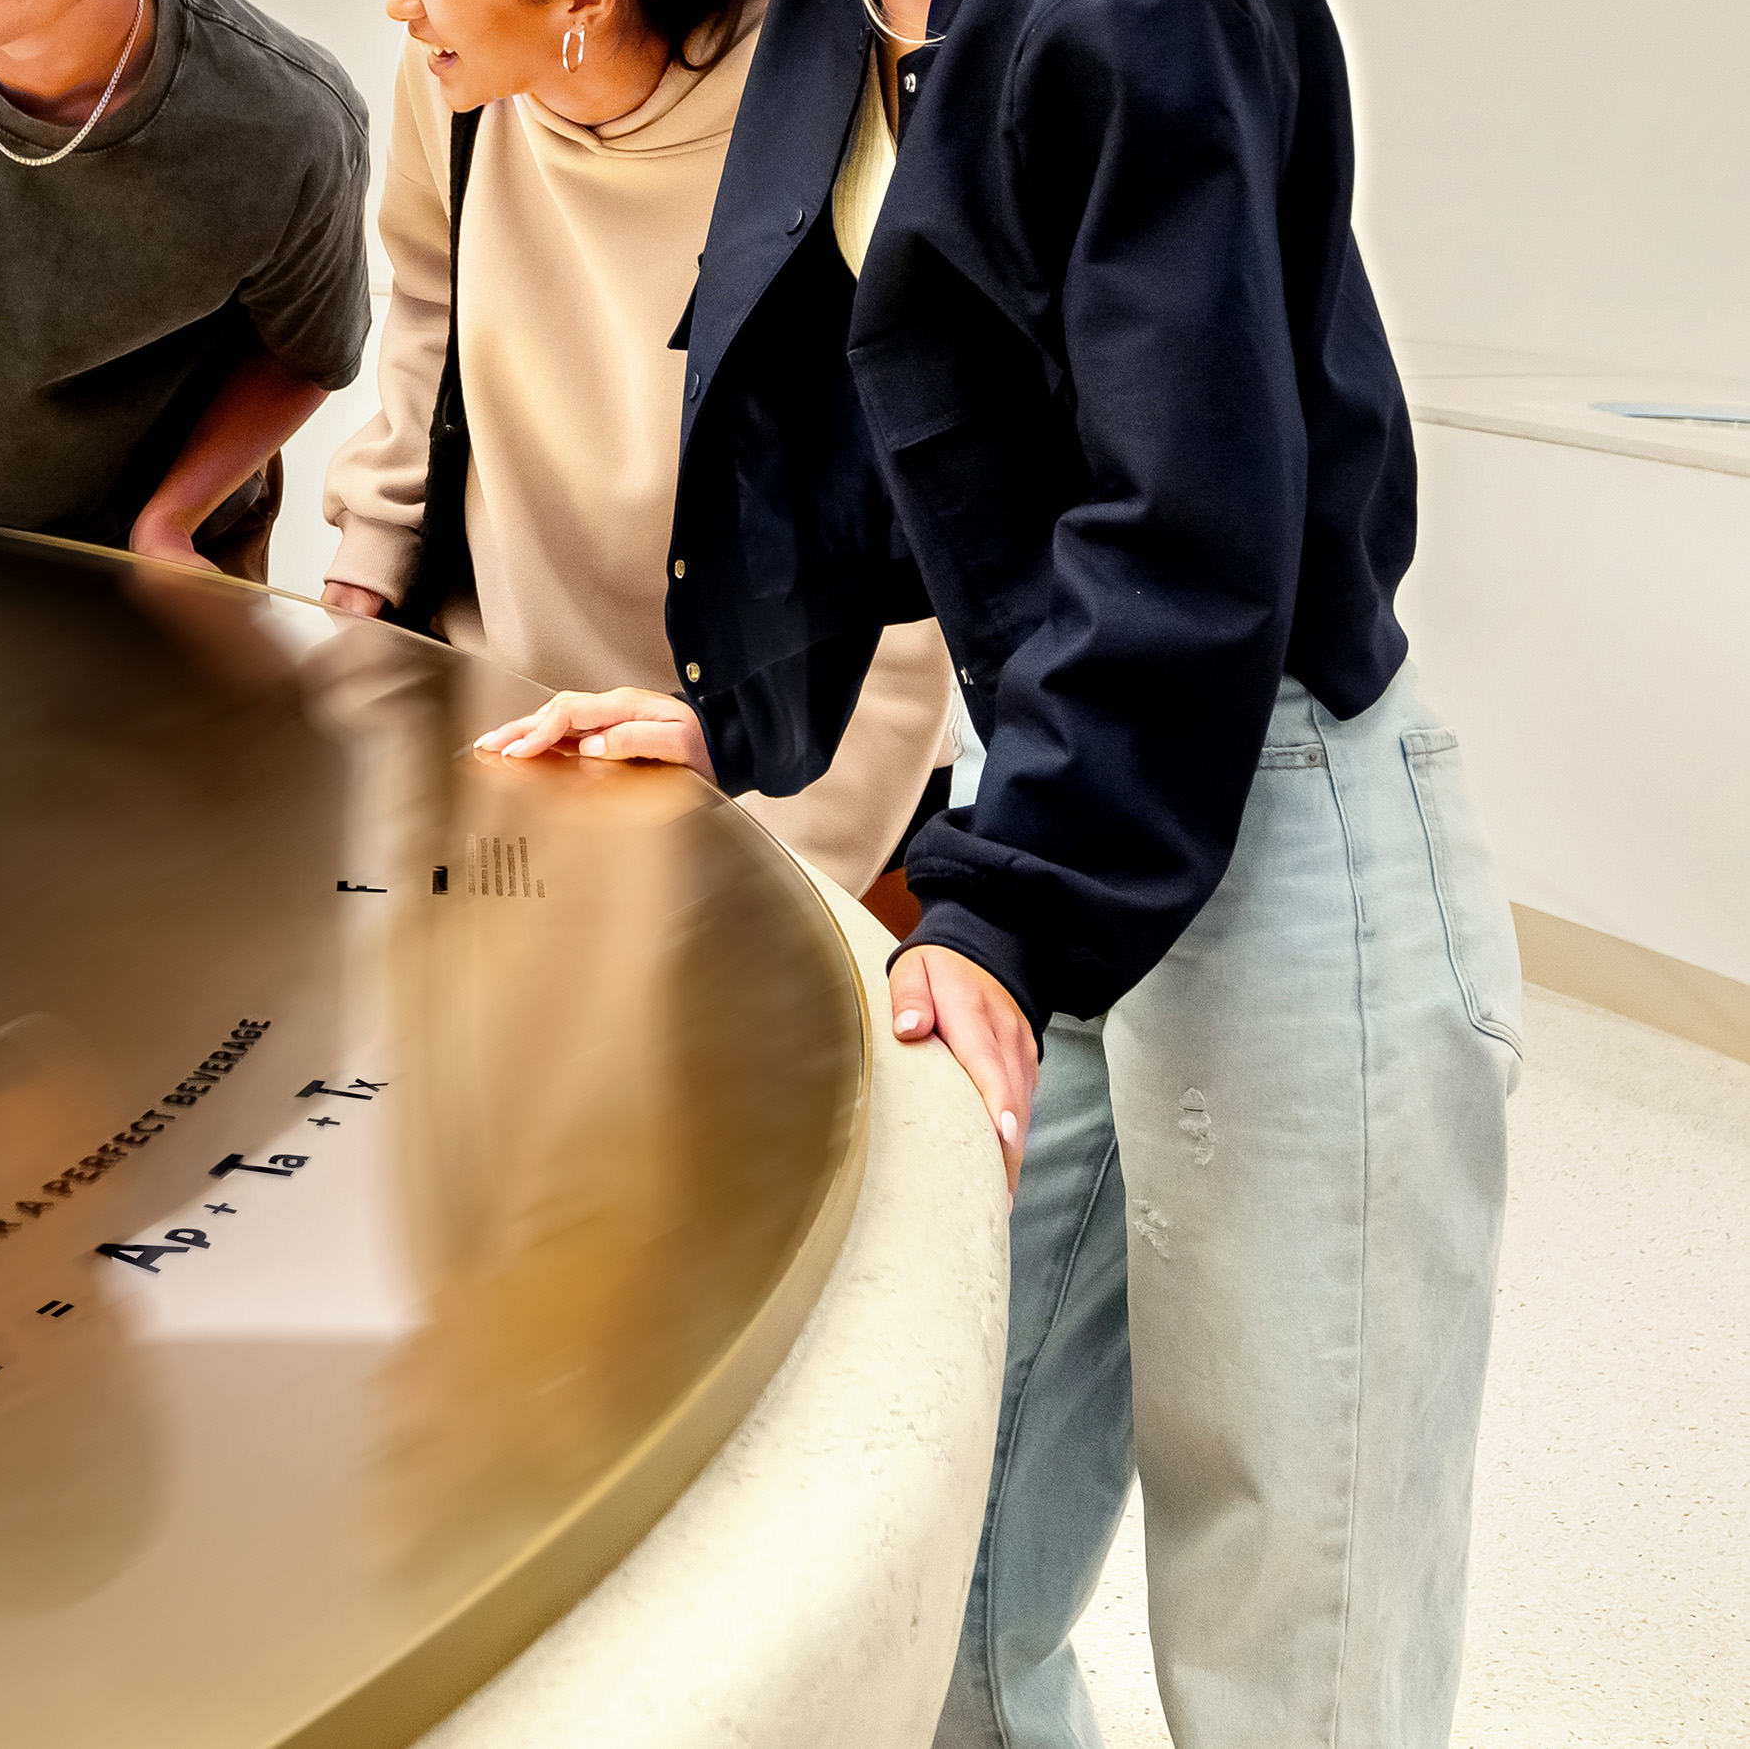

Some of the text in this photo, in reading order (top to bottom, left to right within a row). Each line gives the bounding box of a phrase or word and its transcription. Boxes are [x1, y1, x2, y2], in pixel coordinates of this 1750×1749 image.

[14, 1199, 55, 1219] A
[40, 1108, 178, 1200] PERFECT
[162, 1016, 272, 1110] BEVERAGE
[94, 1226, 213, 1274] Ap
[207, 1152, 312, 1178] Ta
[292, 1076, 390, 1102] Tx
